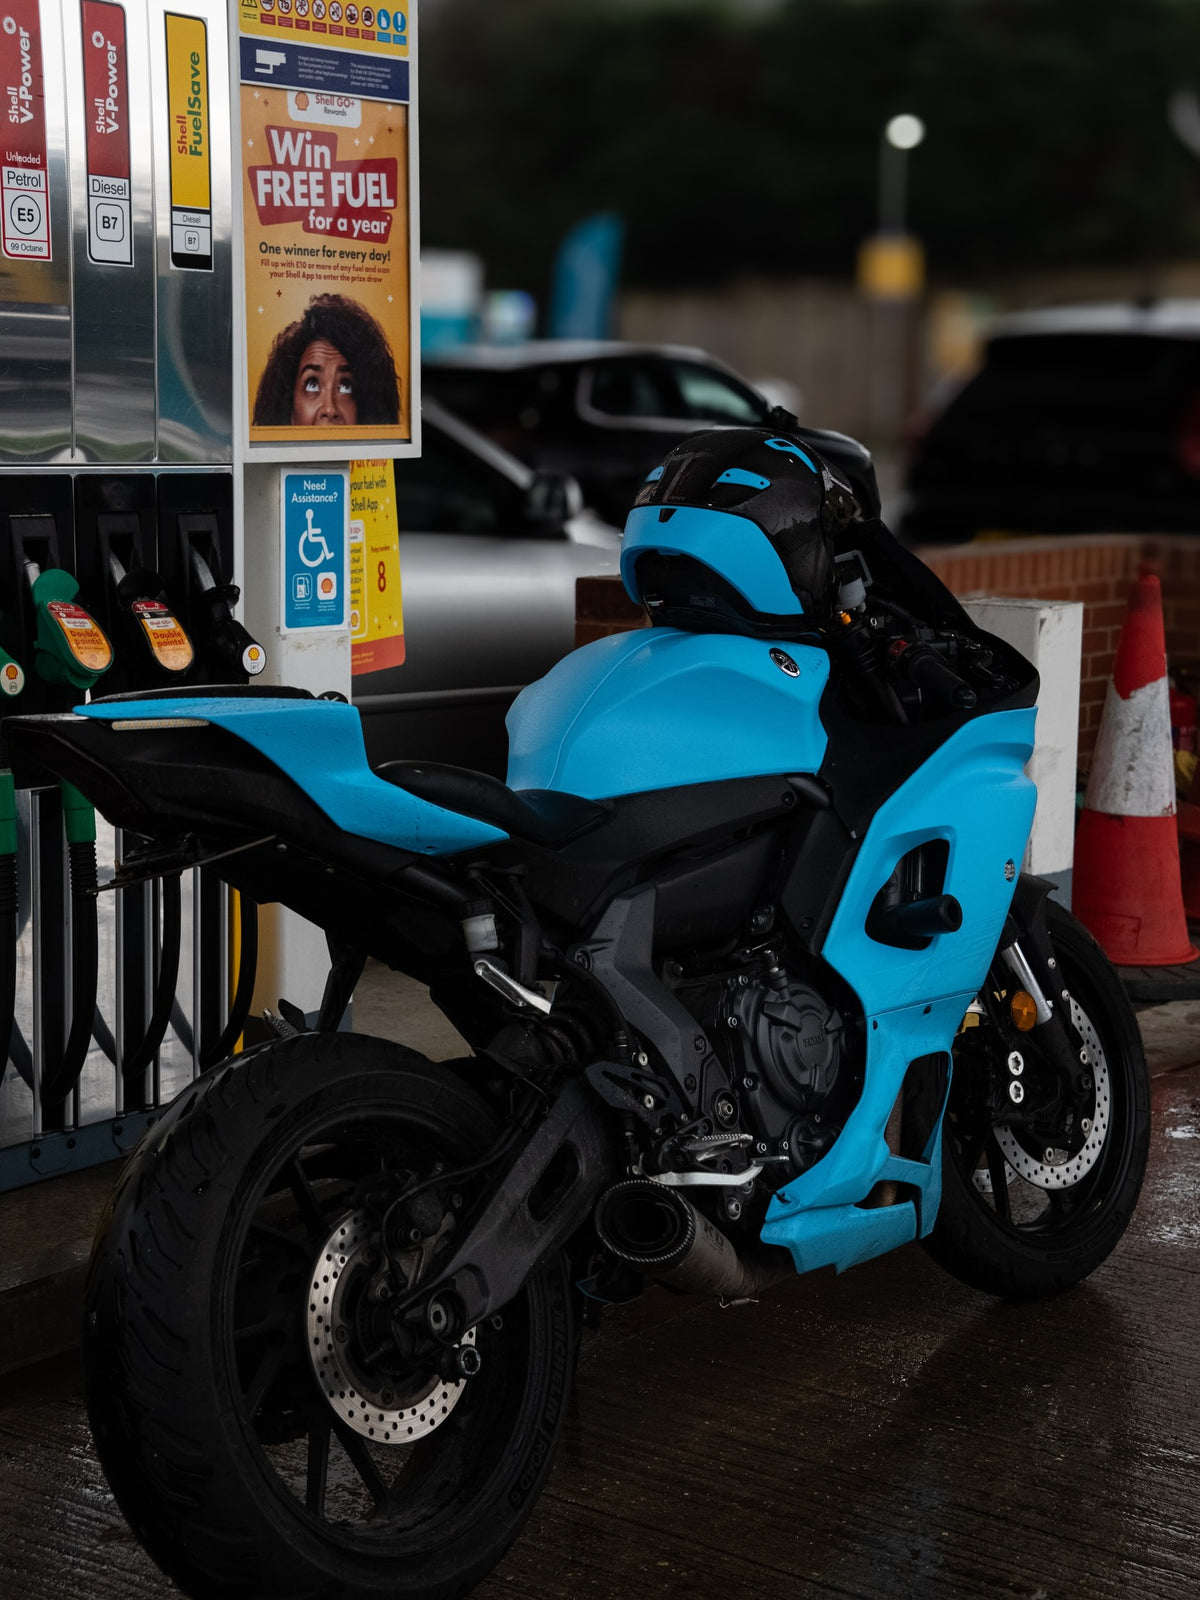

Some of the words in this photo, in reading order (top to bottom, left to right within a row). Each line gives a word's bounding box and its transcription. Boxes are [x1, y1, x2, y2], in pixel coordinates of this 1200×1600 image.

[19, 26, 34, 124] V-Power
[106, 41, 120, 134] V-Power
[7, 86, 19, 123] Shell
[187, 51, 203, 157] FuelSave
[315, 93, 335, 106] Shell
[336, 96, 356, 108] GO+
[95, 98, 105, 134] Shell
[177, 115, 187, 155] Shell
[270, 129, 331, 169] Win
[6, 151, 41, 164] Unleaded
[7, 170, 41, 188] Petrol
[92, 178, 127, 196] Diesel
[256, 170, 325, 207] FREE
[330, 172, 395, 208] FUEL
[17, 207, 35, 223] E5
[102, 216, 118, 230] B7
[182, 214, 201, 224] Diesel
[308, 208, 333, 230] for
[337, 218, 347, 231] a
[10, 242, 19, 251] 99
[20, 243, 43, 253] Octane
[187, 236, 196, 245] B7
[259, 241, 282, 255] One
[284, 243, 320, 257] winner
[321, 245, 337, 258] for
[339, 249, 367, 263] every
[369, 248, 391, 264] day!
[260, 259, 270, 267] Fill
[270, 261, 279, 269] up
[280, 260, 295, 268] with
[295, 261, 306, 269] £10
[332, 263, 340, 271] of
[340, 265, 352, 274] any
[352, 264, 364, 273] fuel
[364, 265, 377, 273] and
[285, 270, 301, 279] Shell
[301, 272, 315, 281] App
[350, 275, 366, 283] prize
[303, 479, 327, 491] Need
[363, 475, 374, 490] fuel
[291, 492, 338, 504] Assistance?
[351, 497, 365, 512] Shell
[367, 498, 378, 514] App
[377, 560, 387, 592] 8
[74, 637, 103, 646] points!
[152, 630, 182, 639] Double
[157, 638, 185, 648] points!
